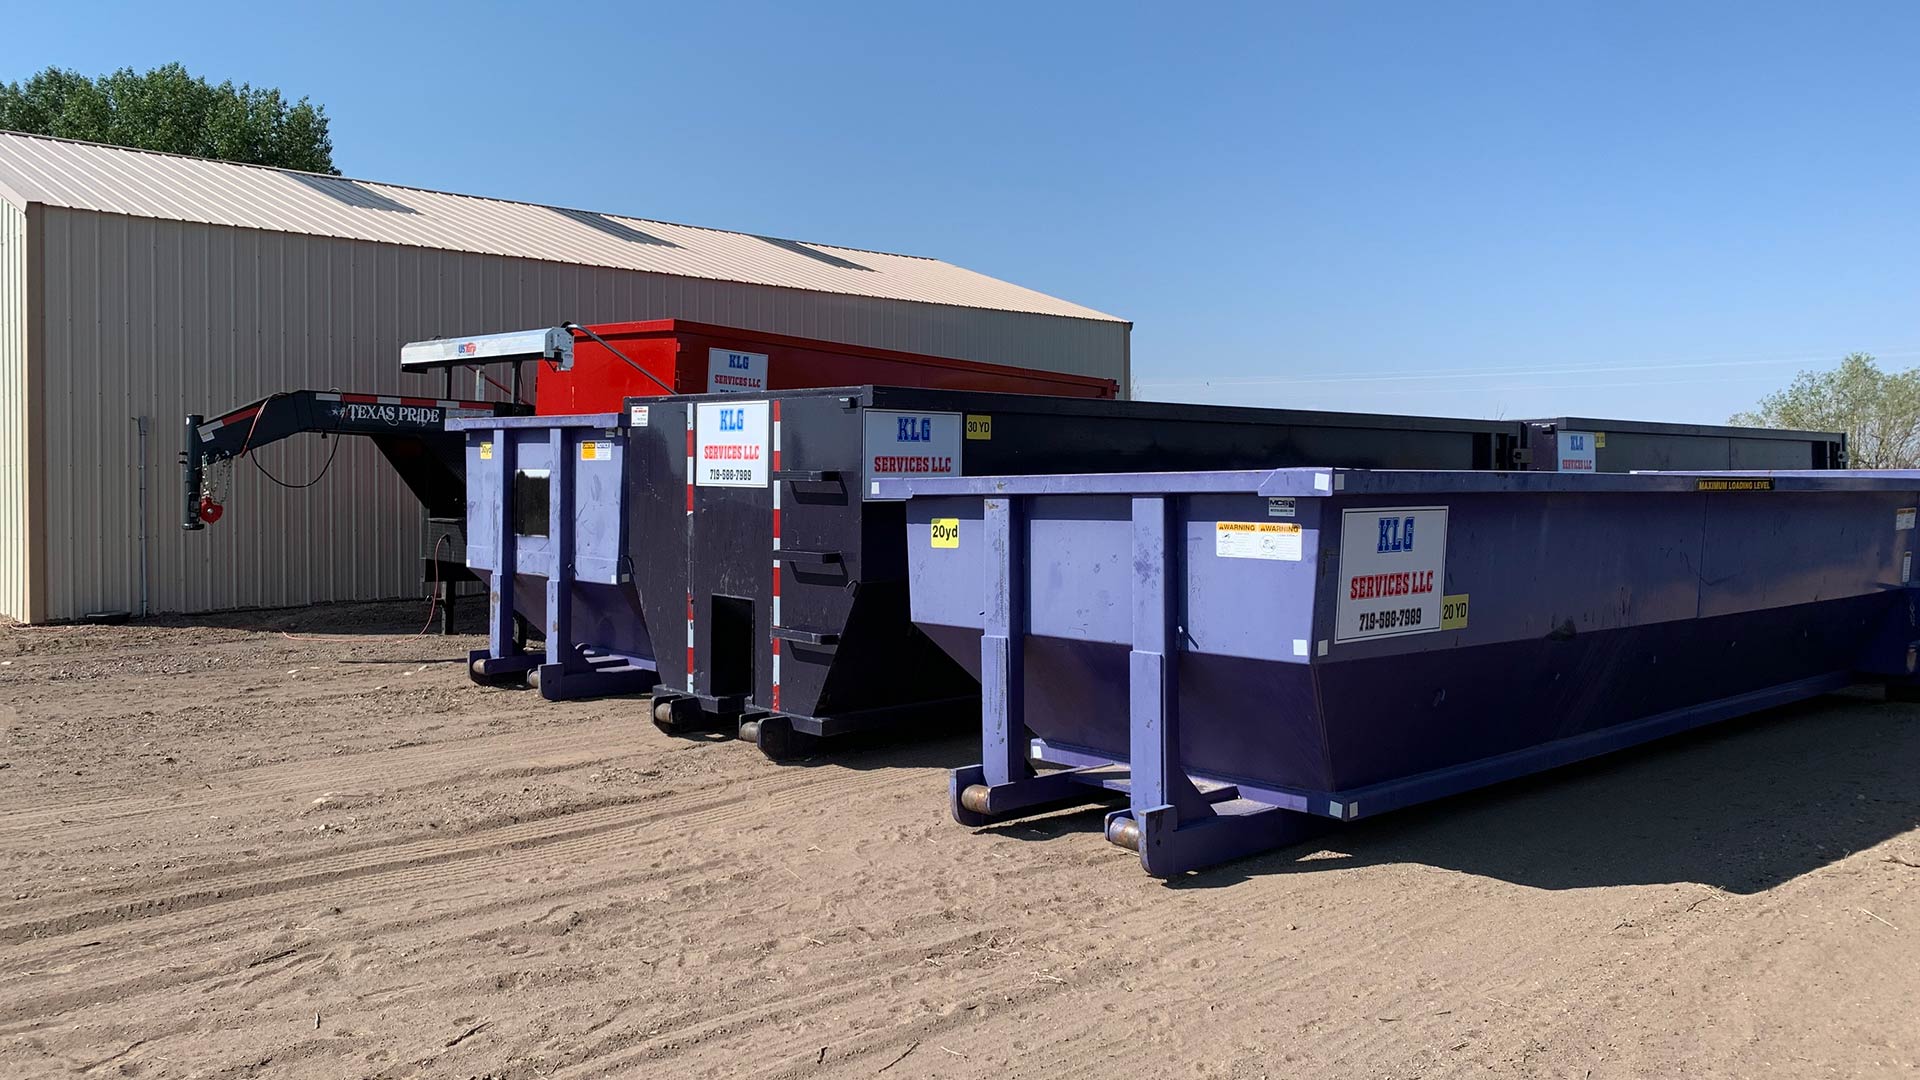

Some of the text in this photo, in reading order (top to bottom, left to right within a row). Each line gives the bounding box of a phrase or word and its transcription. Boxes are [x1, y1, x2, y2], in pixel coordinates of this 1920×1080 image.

[729, 354, 749, 369] KLG
[714, 374, 761, 387] SERVICES LLC
[347, 404, 440, 426] TEXAS PRIDE
[720, 409, 744, 431] KLG
[897, 417, 931, 442] KLG
[967, 421, 990, 433] 30 YD
[704, 445, 760, 460] SERVICES LLC
[874, 456, 951, 473] SERVICES LLC
[710, 469, 752, 481] 719-588-7989
[1698, 481, 1770, 490] MAXIMUM LOADING LEVEL
[932, 525, 958, 541] 20yd
[1223, 523, 1256, 531] WARNING
[1377, 516, 1415, 553] KLG
[1350, 570, 1434, 601] SERVICES LLC
[1443, 602, 1467, 620] 20 YD
[1359, 607, 1422, 632] 719-588-7989
